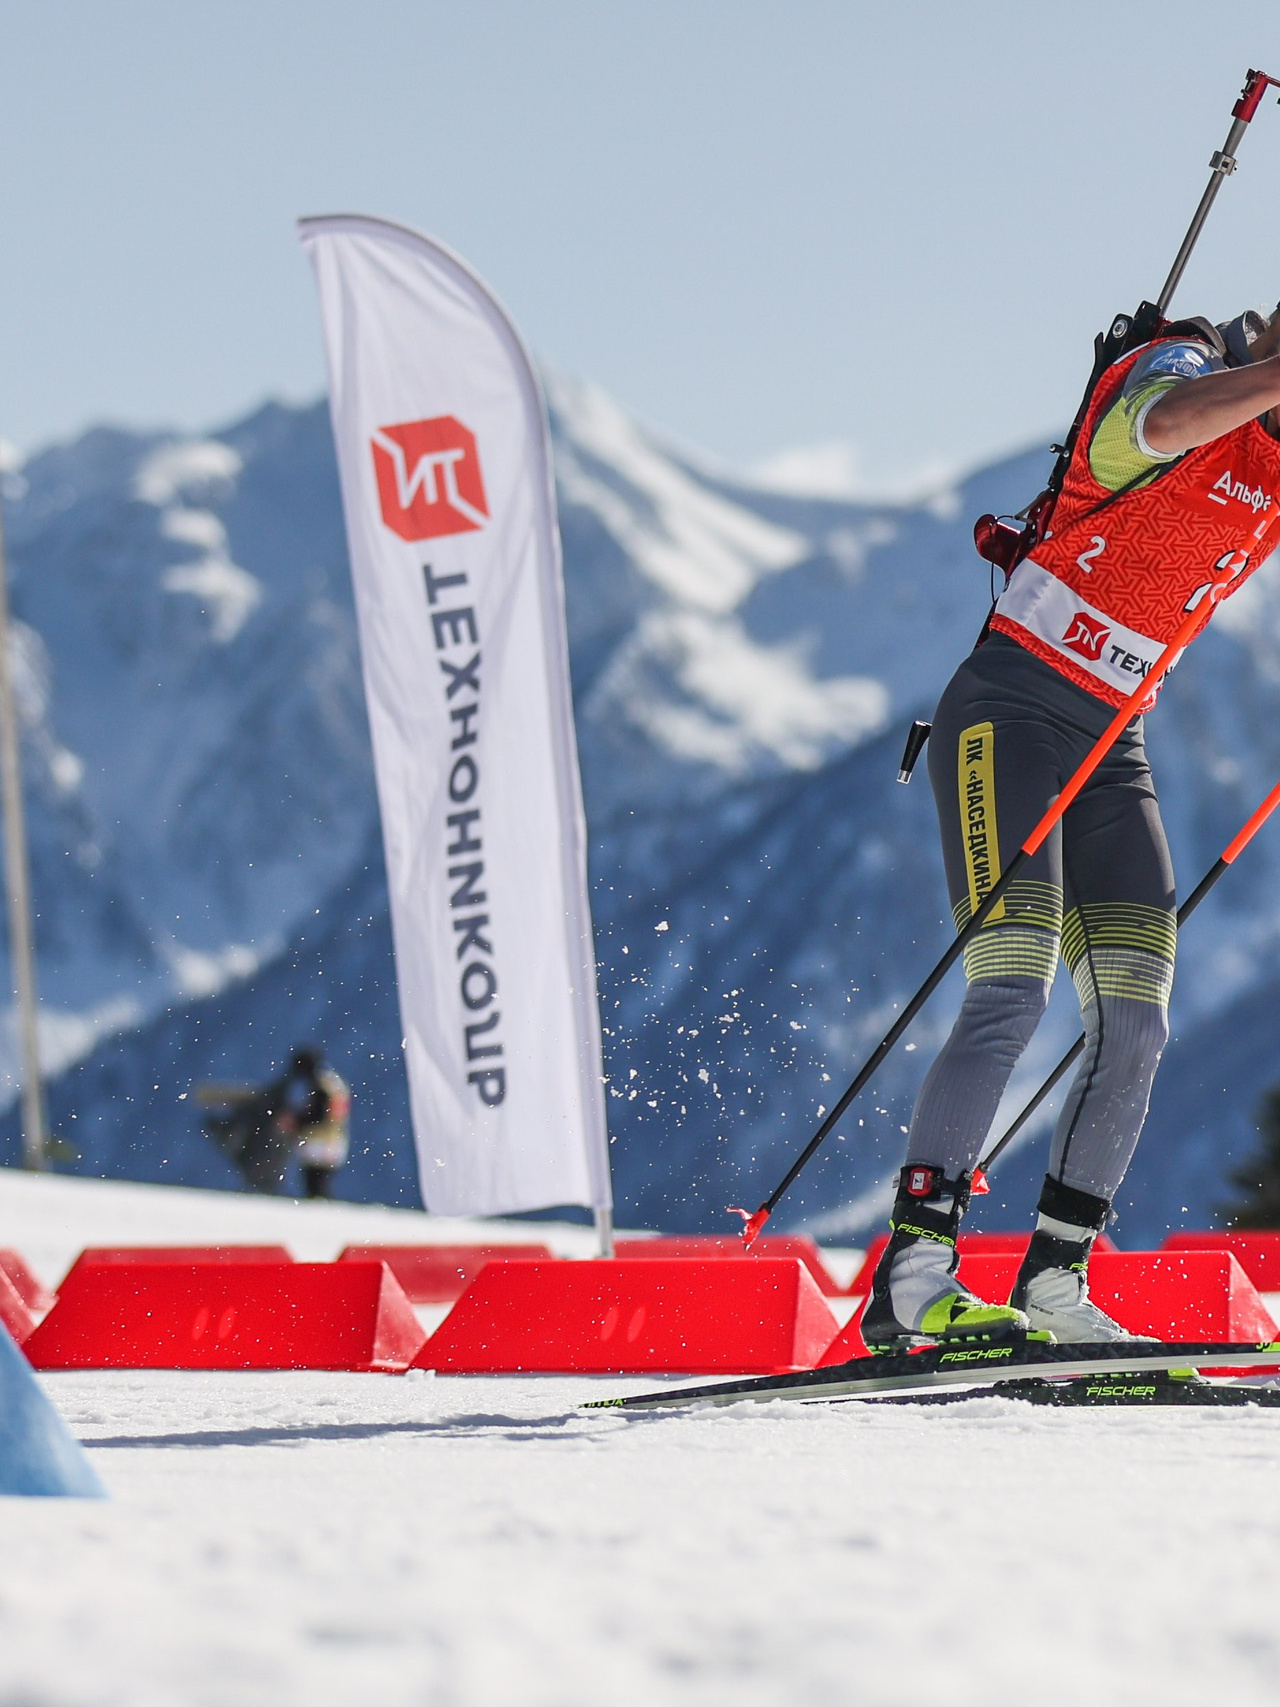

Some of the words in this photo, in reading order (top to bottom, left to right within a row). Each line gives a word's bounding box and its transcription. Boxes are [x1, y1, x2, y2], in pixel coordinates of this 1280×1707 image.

[1075, 535, 1106, 574] 2
[965, 737, 983, 766] ЛК
[939, 1347, 1013, 1363] FISCHER
[1086, 1385, 1156, 1397] FISCHER
